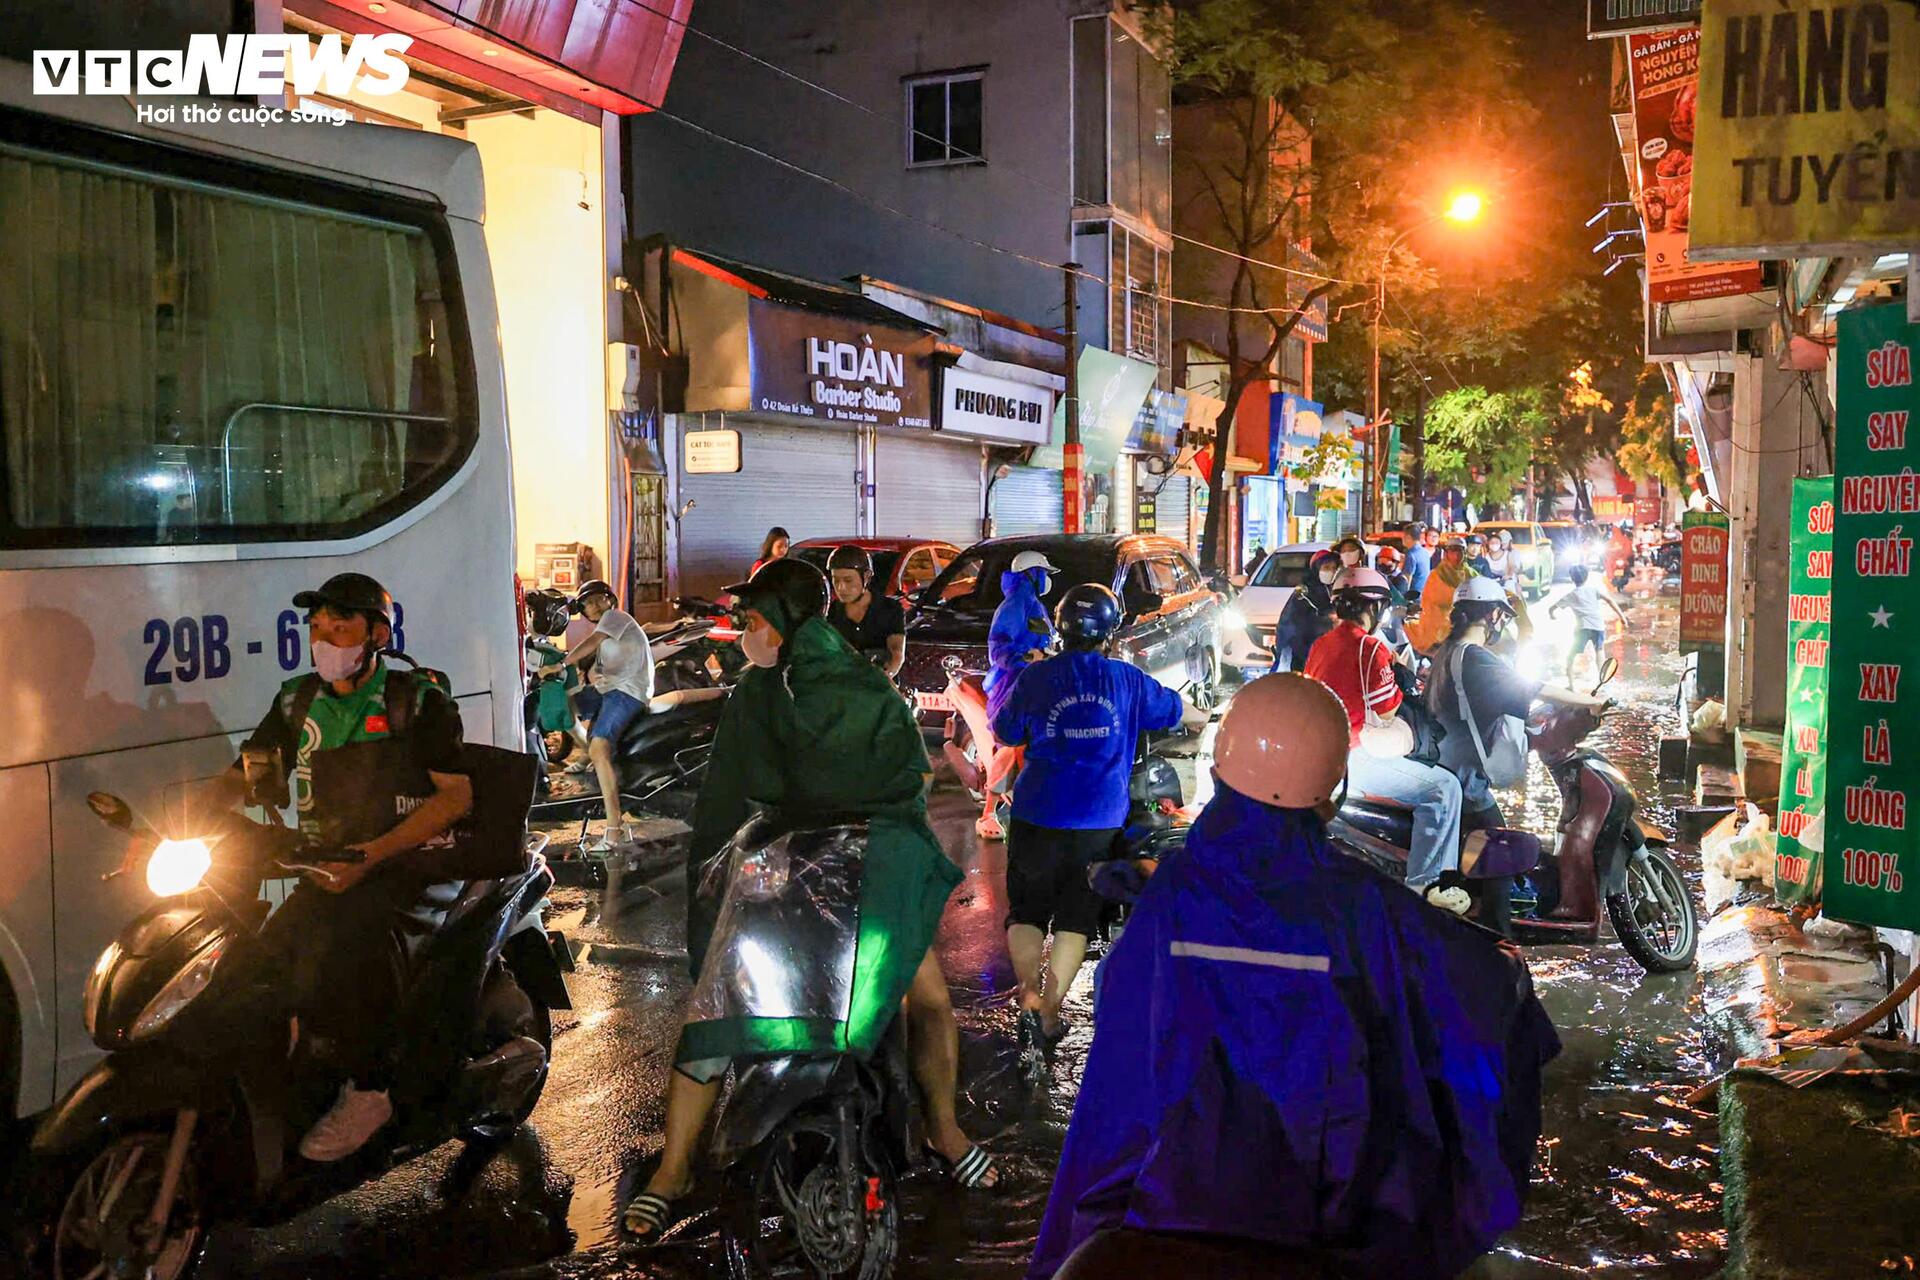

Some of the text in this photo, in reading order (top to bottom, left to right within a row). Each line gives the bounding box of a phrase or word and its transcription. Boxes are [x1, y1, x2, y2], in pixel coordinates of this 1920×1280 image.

[1634, 45, 1648, 58] GÀ
[1650, 39, 1671, 54] RÁN
[809, 333, 904, 388] HOÀN
[1867, 340, 1911, 388] SỮA
[814, 380, 902, 412] Barber Studio
[1867, 410, 1909, 452] SAY
[1842, 466, 1920, 514] NGUYÊN
[1807, 550, 1832, 578] SAY
[1855, 524, 1913, 577] CHẤT
[1691, 563, 1719, 583] DINH
[1789, 590, 1832, 624] NGUYÊ
[143, 614, 232, 686] 29B
[1858, 663, 1900, 703] XAY
[1863, 719, 1891, 765] LÀ
[1845, 775, 1906, 830] UỐNG
[1842, 848, 1902, 892] 100%
